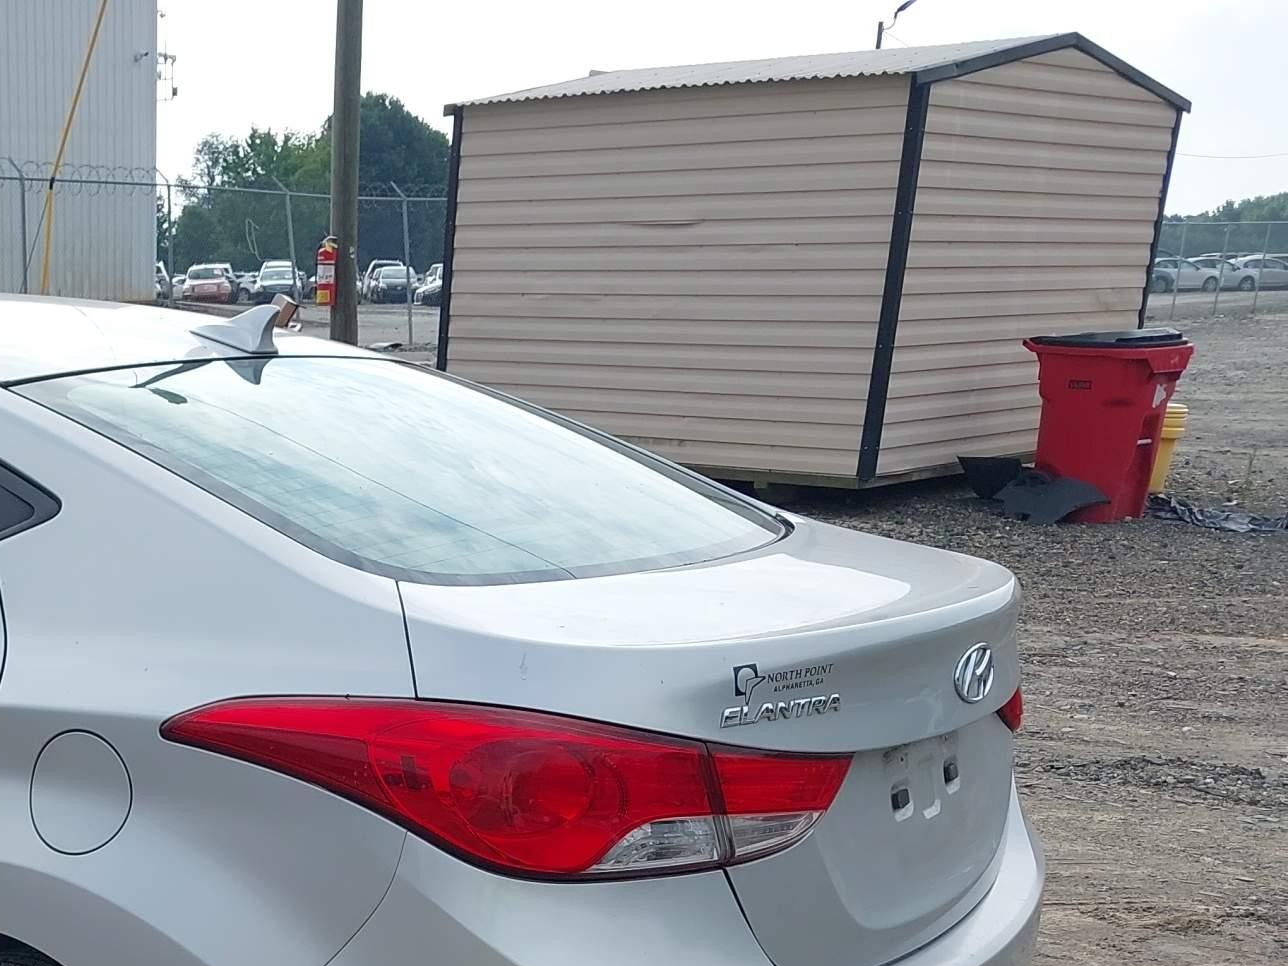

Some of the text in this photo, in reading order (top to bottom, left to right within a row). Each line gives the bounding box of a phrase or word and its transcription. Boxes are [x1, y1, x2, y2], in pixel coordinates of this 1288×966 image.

[767, 663, 834, 684] NORTH POINT
[720, 693, 841, 728] ELANTRA
